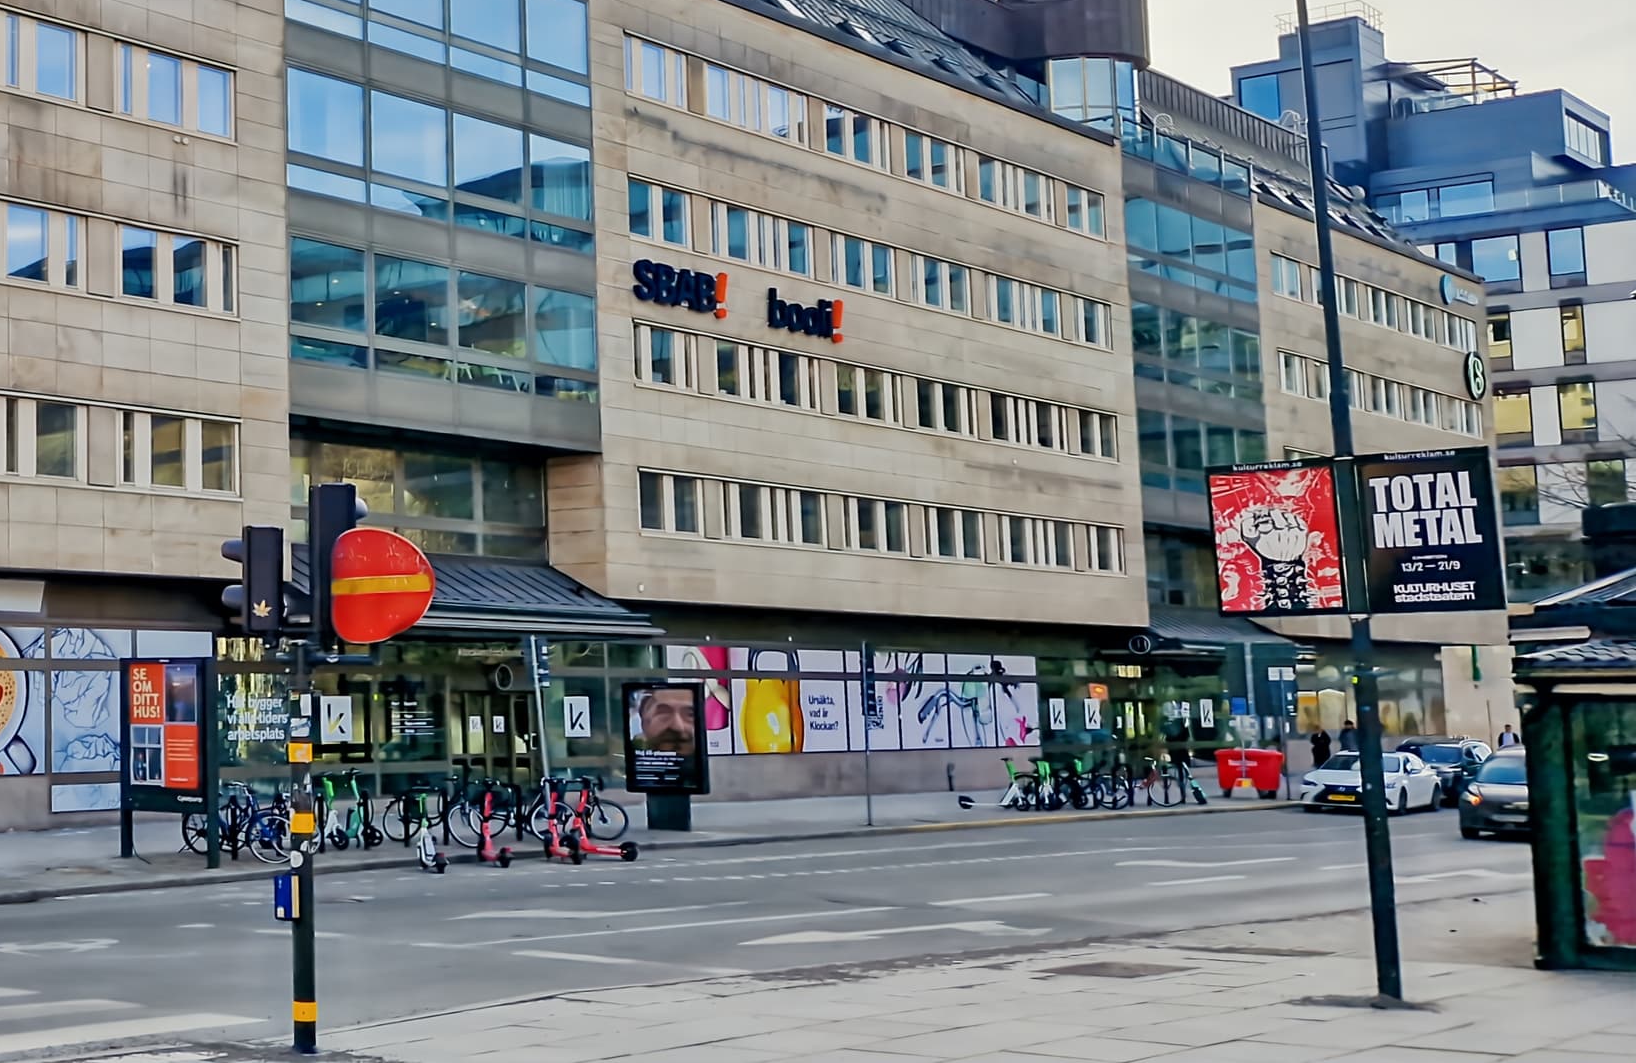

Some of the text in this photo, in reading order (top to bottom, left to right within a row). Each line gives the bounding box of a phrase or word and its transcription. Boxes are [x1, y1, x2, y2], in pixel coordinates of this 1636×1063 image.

[633, 259, 728, 319] SBAB!
[1383, 449, 1456, 461] kulturreklam.se
[1232, 460, 1303, 472] kulturreklam.se
[1368, 470, 1478, 513] TOTAL
[1372, 507, 1483, 549] METAL
[1401, 561, 1424, 572] 13/2
[1437, 559, 1461, 571] 21/9
[1393, 580, 1476, 594] KULTURHUSET
[1394, 591, 1476, 603] stadsteatern
[132, 668, 147, 681] SE
[132, 680, 152, 693] OM
[133, 693, 159, 706] DITT
[248, 695, 283, 711] bygger
[133, 706, 161, 719] HUS!
[227, 712, 237, 724] vi
[259, 711, 288, 724] tiders
[227, 727, 285, 743] arbetsplats
